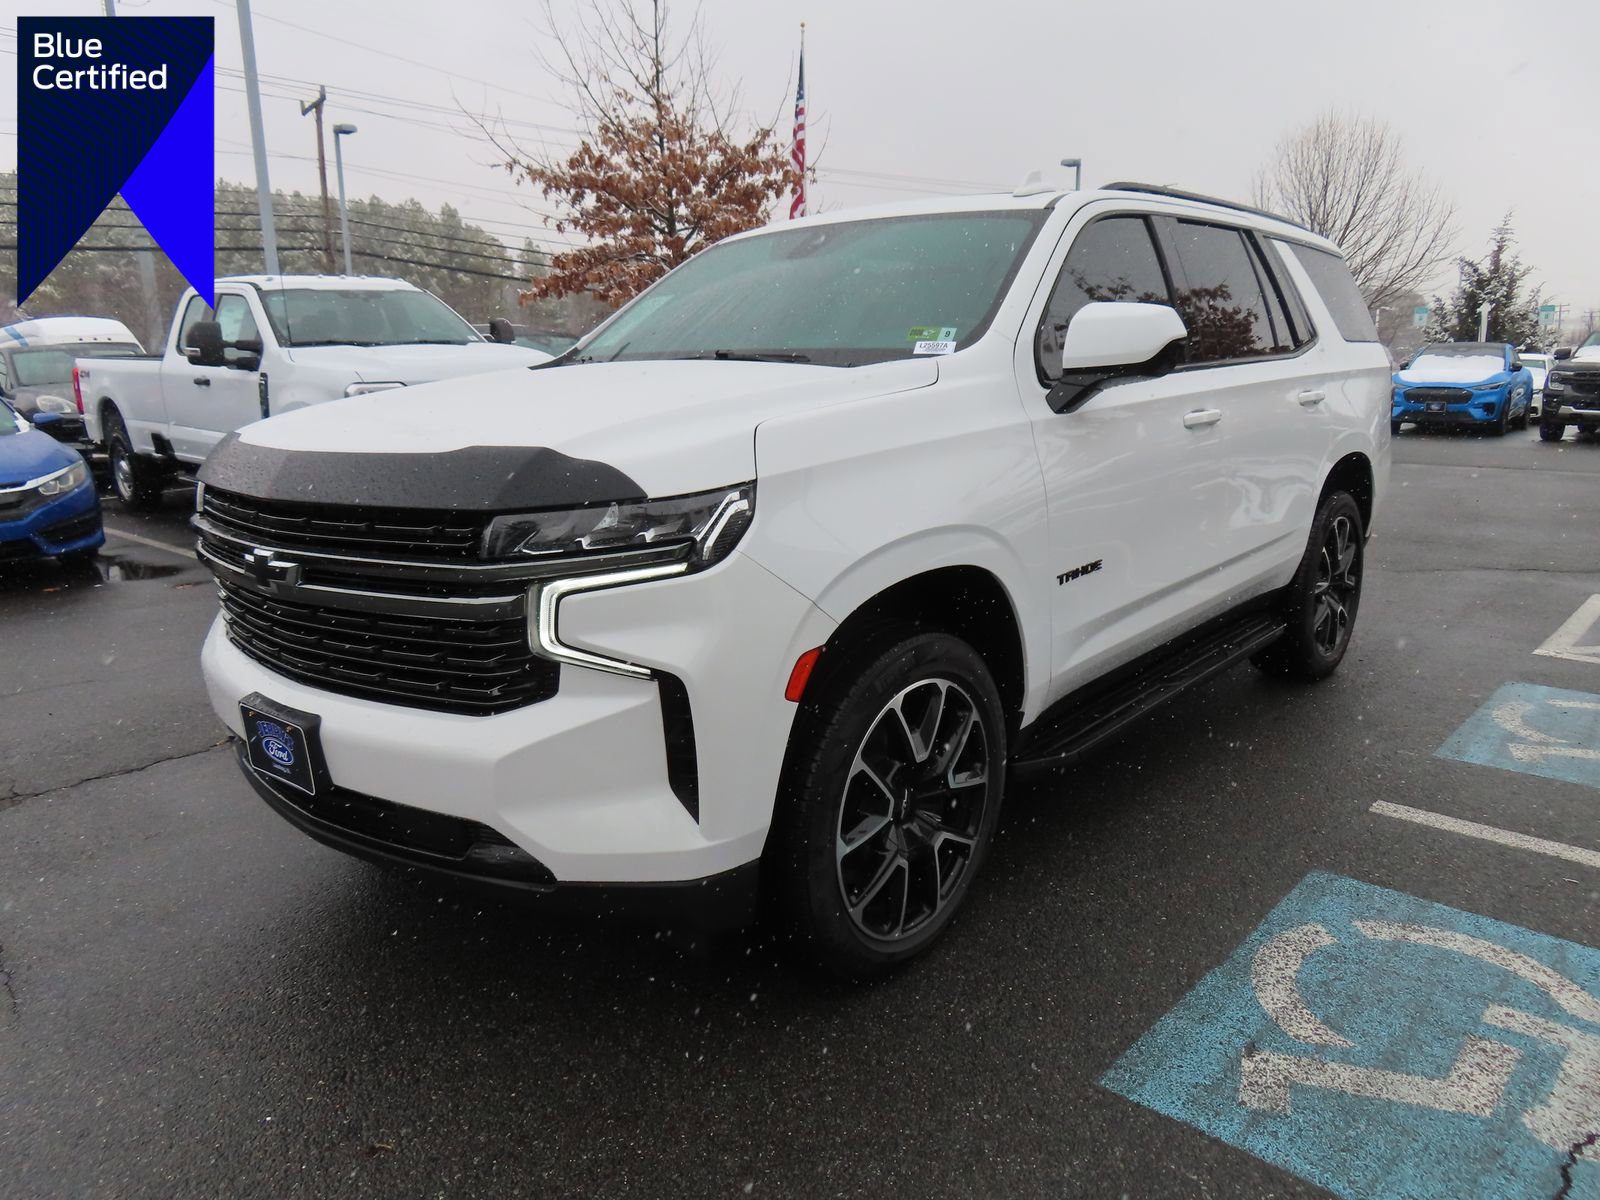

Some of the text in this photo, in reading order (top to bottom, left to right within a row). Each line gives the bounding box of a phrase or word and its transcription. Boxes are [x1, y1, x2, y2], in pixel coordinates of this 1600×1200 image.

[944, 330, 951, 338] 9
[1056, 559, 1103, 586] TAHOE
[268, 740, 289, 762] Ford
